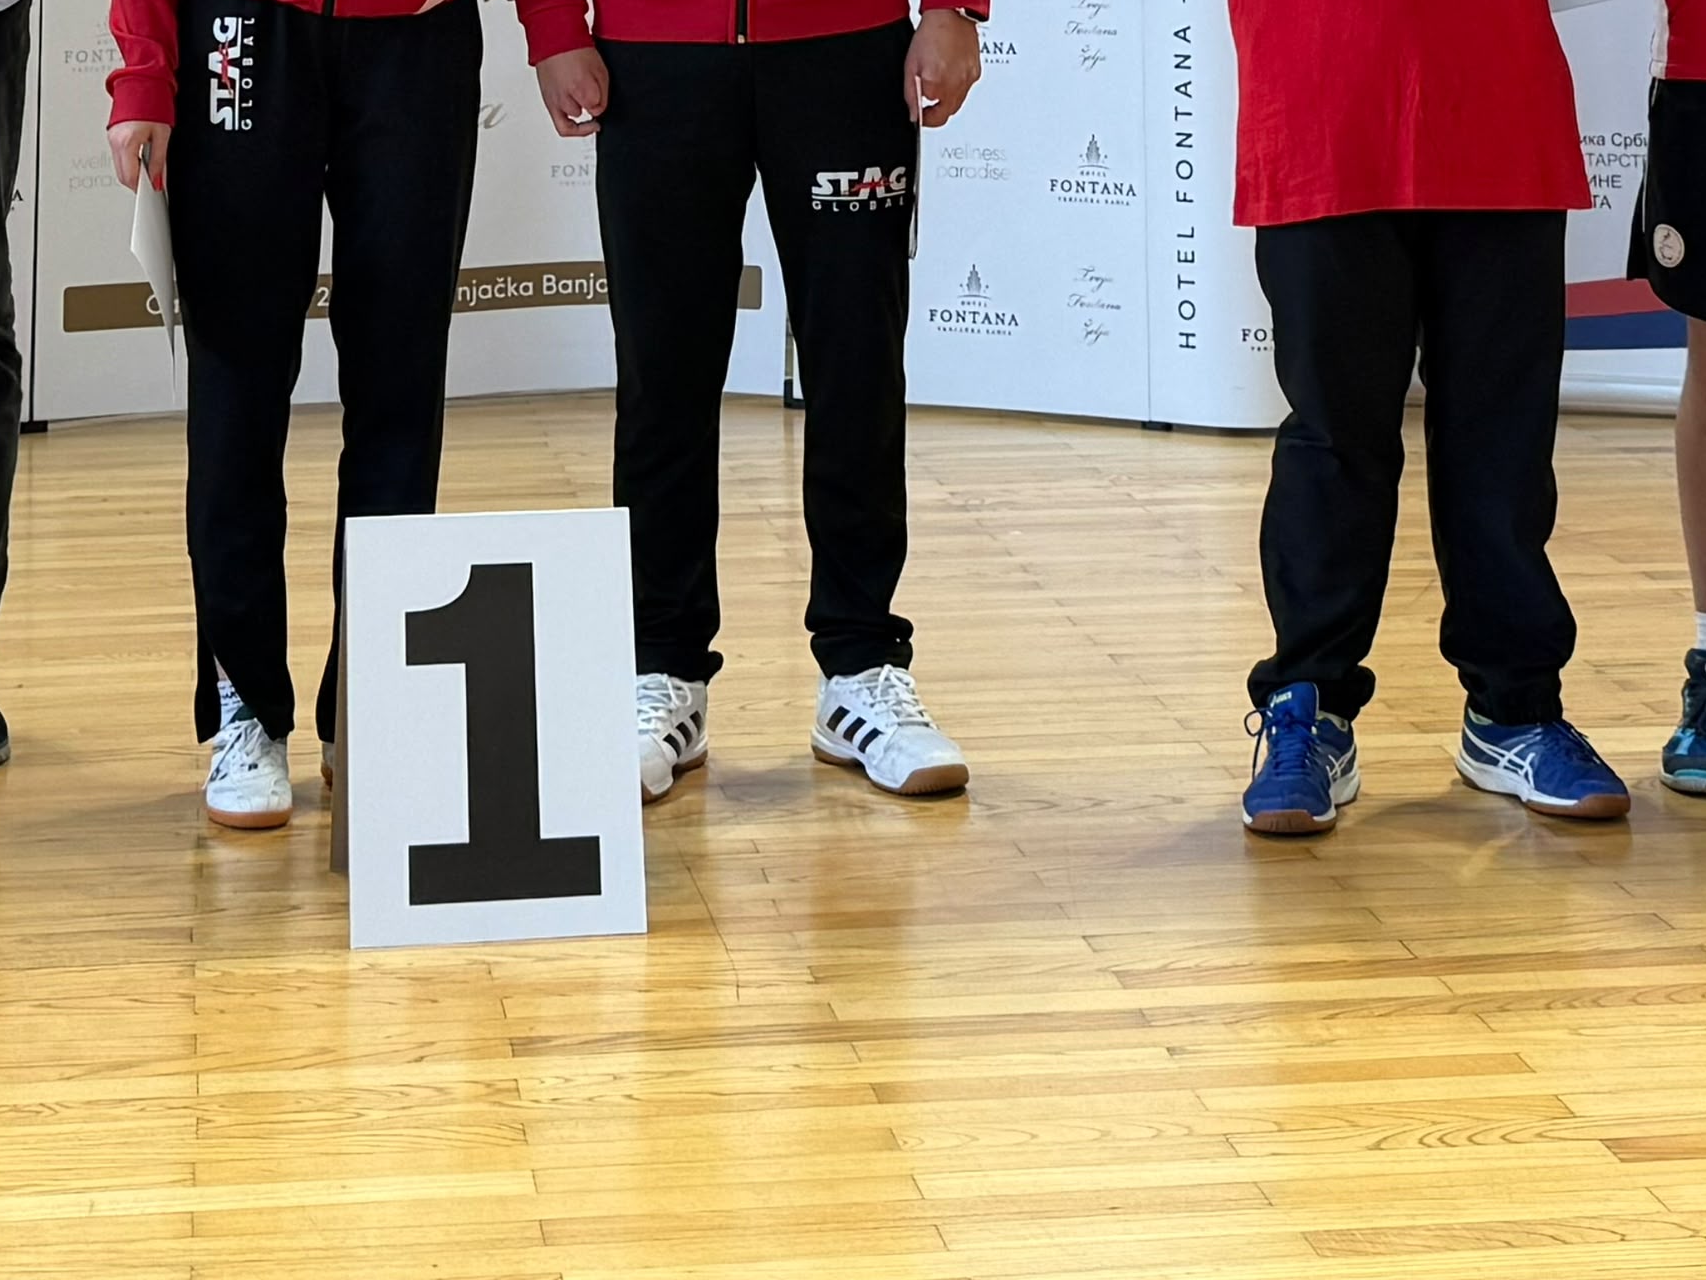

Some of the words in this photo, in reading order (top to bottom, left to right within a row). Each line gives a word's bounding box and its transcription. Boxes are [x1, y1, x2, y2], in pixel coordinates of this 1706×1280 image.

[208, 16, 236, 131] STAG
[240, 16, 255, 132] GLOBAL
[1173, 25, 1196, 203] FONTANA
[811, 166, 907, 199] STAG
[812, 195, 907, 212] GLOBAL
[1049, 179, 1137, 197] FONTANA
[457, 275, 535, 302] njačka
[928, 308, 1020, 328] FONTANA
[1177, 226, 1197, 350] HOTEL
[405, 562, 602, 906] 1
